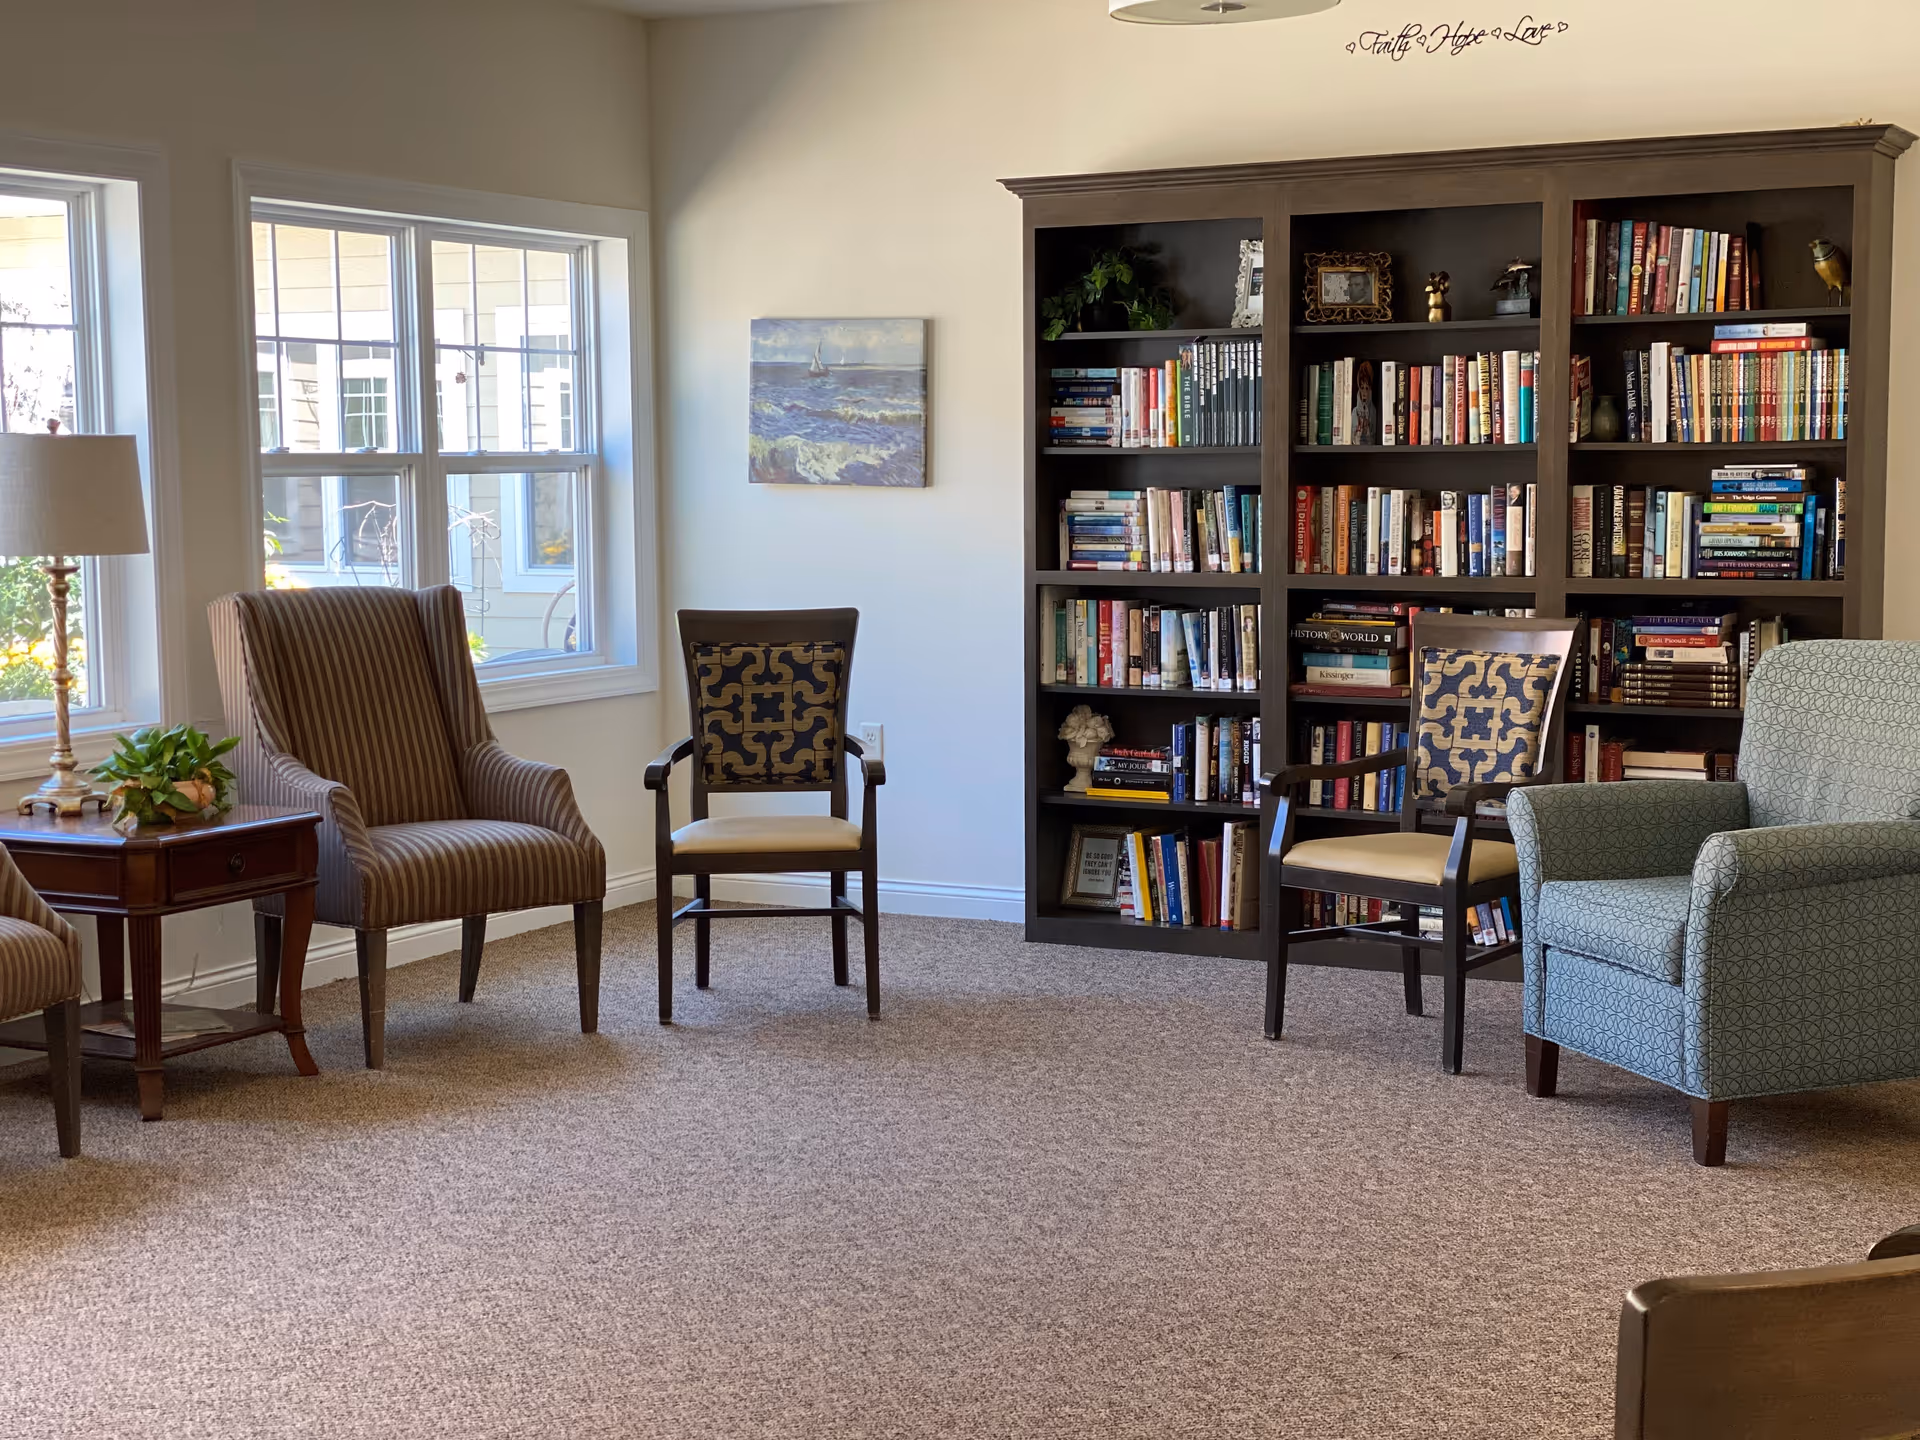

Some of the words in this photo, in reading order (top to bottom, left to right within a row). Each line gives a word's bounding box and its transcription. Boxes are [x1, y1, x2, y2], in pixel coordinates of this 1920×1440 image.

[1360, 23, 1422, 61] Faith
[1426, 21, 1488, 55] Hope
[1504, 15, 1554, 45] Love
[1635, 236, 1643, 246] LEE
[1641, 352, 1649, 371] ROSE
[1626, 371, 1634, 389] Nelson
[1779, 504, 1795, 513] EIGHT
[1290, 630, 1329, 639] HISTORY
[1341, 632, 1378, 642] WORLD
[1320, 670, 1355, 681] Kissinger
[1572, 758, 1580, 774] Silva
